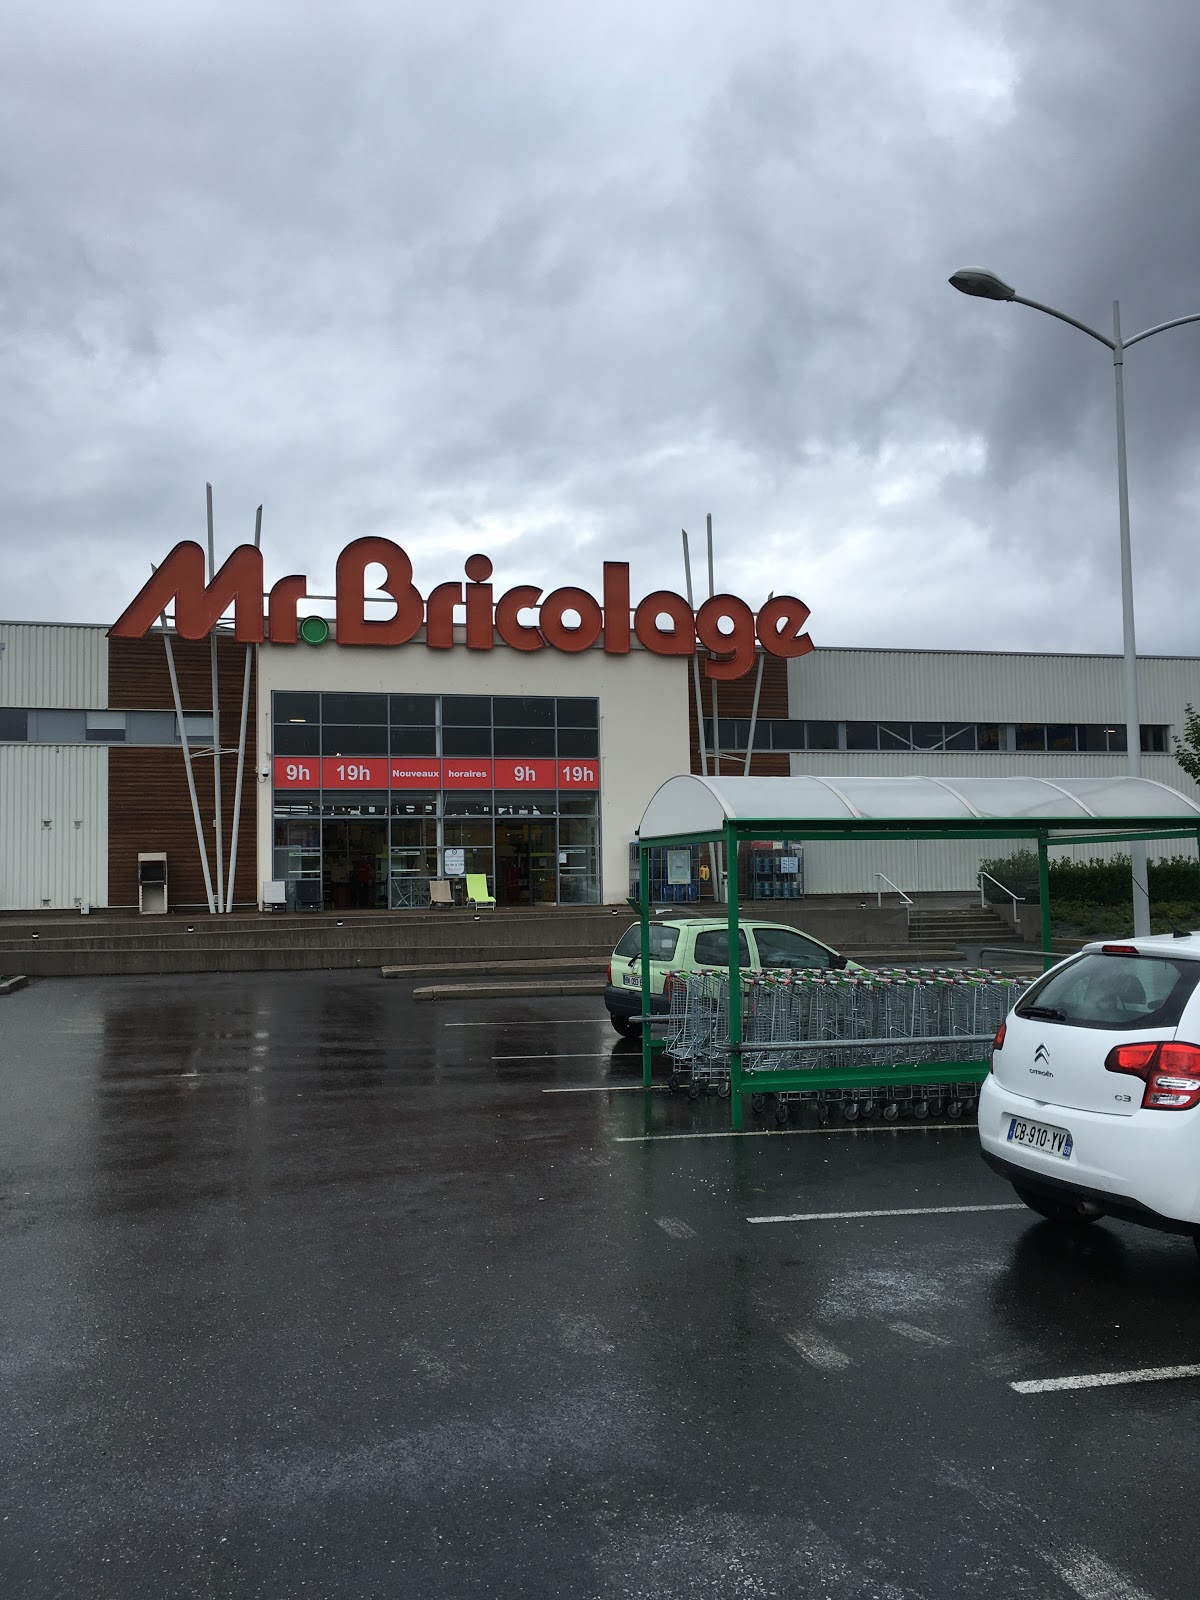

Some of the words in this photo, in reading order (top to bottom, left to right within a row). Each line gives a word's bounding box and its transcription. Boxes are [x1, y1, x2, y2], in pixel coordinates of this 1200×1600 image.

[105, 540, 330, 646] Mr.
[336, 536, 815, 680] Bricolage
[286, 764, 310, 781] 9h
[336, 764, 371, 781] 19h
[392, 769, 439, 778] Nouveaux
[448, 769, 487, 778] horaires
[514, 766, 536, 782] 9h
[562, 766, 594, 782] 19h
[1114, 1094, 1132, 1103] C3
[1014, 1122, 1066, 1152] CB-910-YV
